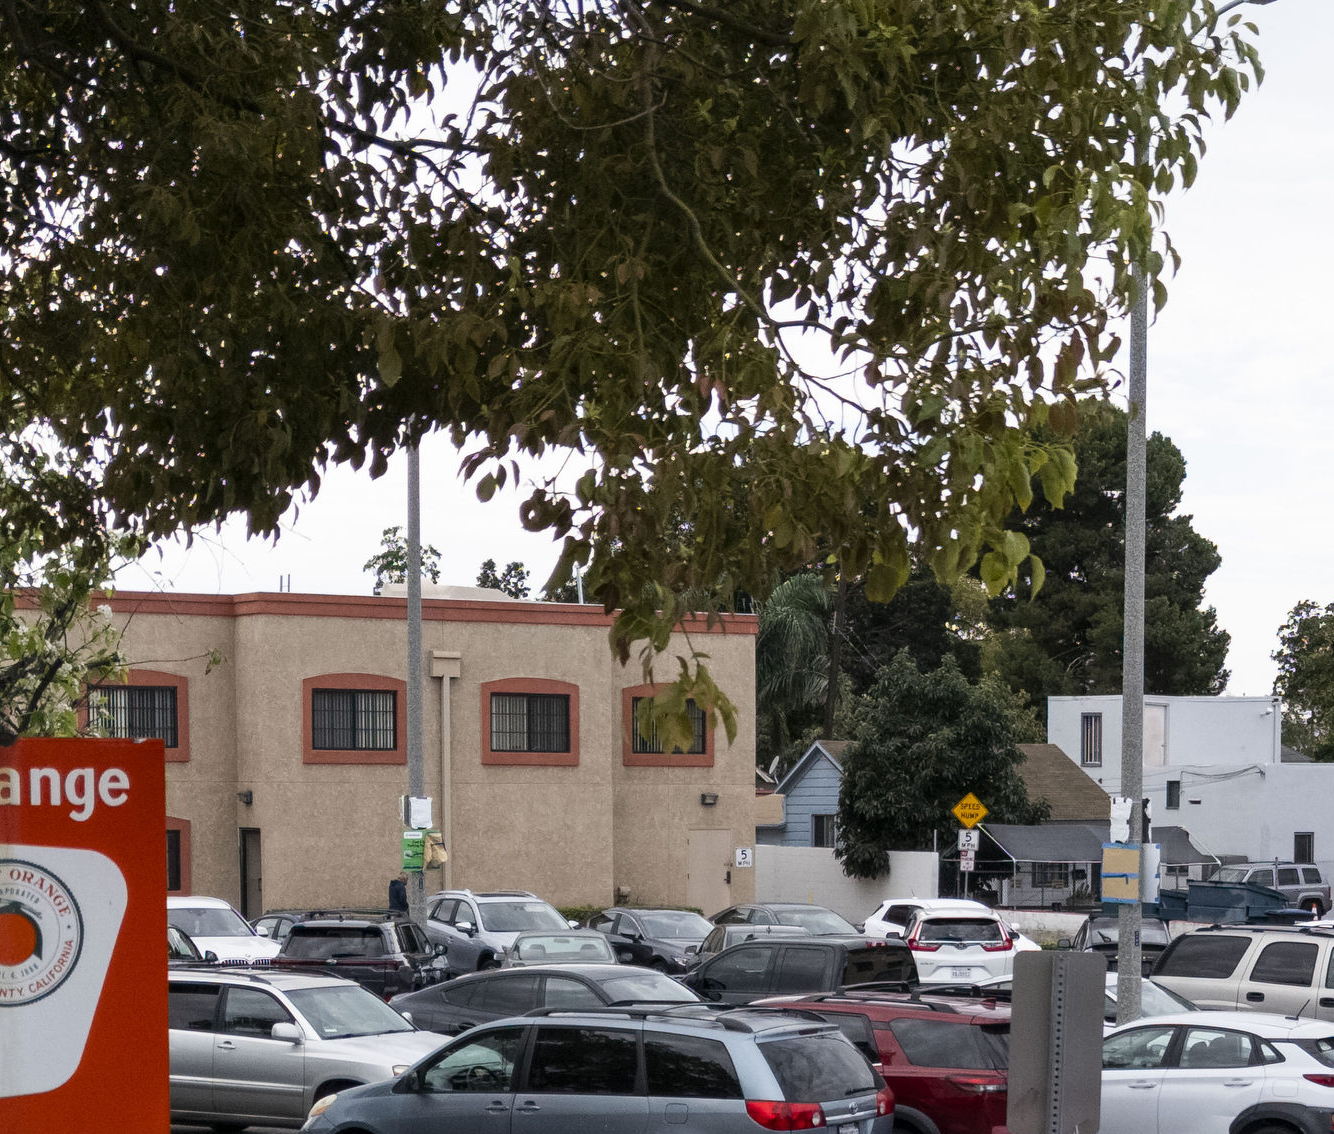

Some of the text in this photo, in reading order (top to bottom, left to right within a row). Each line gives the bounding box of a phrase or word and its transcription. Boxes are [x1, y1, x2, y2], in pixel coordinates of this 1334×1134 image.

[966, 832, 972, 842] 5
[741, 849, 747, 859] 5
[9, 868, 72, 917] ORANGE
[28, 939, 75, 994] CALIFORNIA
